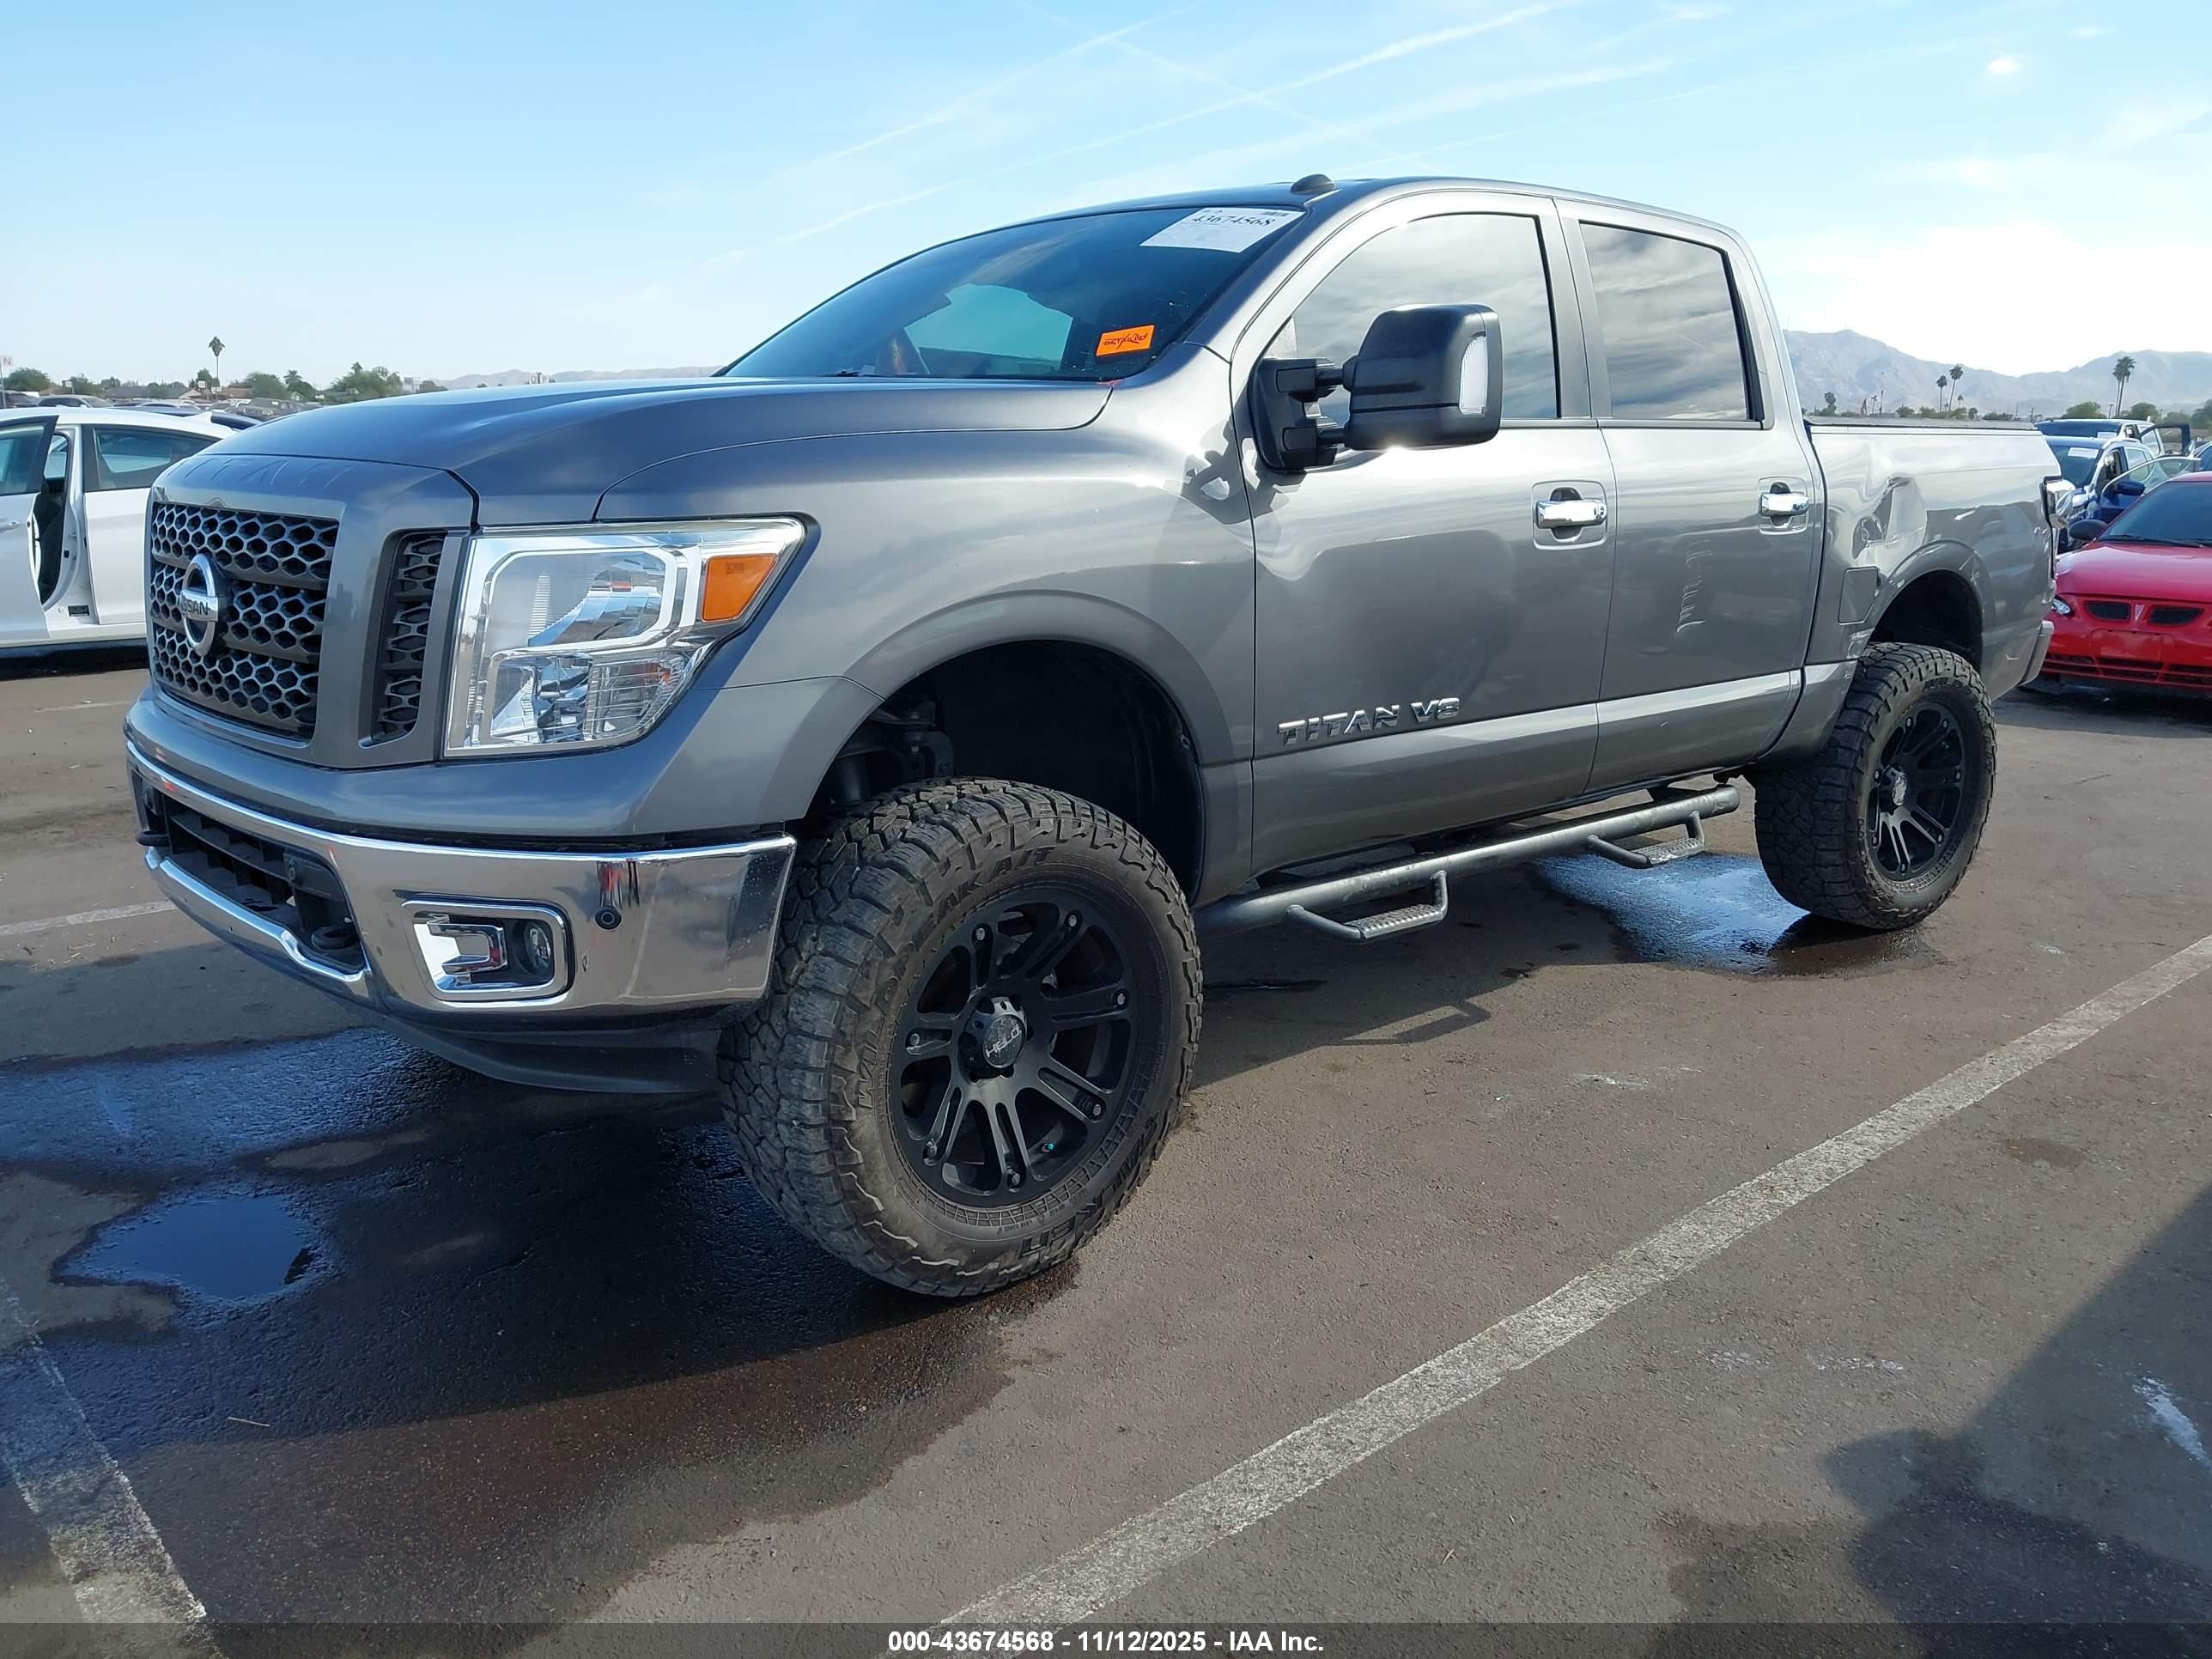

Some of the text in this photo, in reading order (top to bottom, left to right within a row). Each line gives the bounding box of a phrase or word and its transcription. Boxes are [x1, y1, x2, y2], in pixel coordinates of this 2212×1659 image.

[1191, 214, 1277, 228] 43674568
[180, 594, 209, 616] SSAN
[1278, 697, 1462, 745] TITAN V8
[985, 1024, 1022, 1058] HELO
